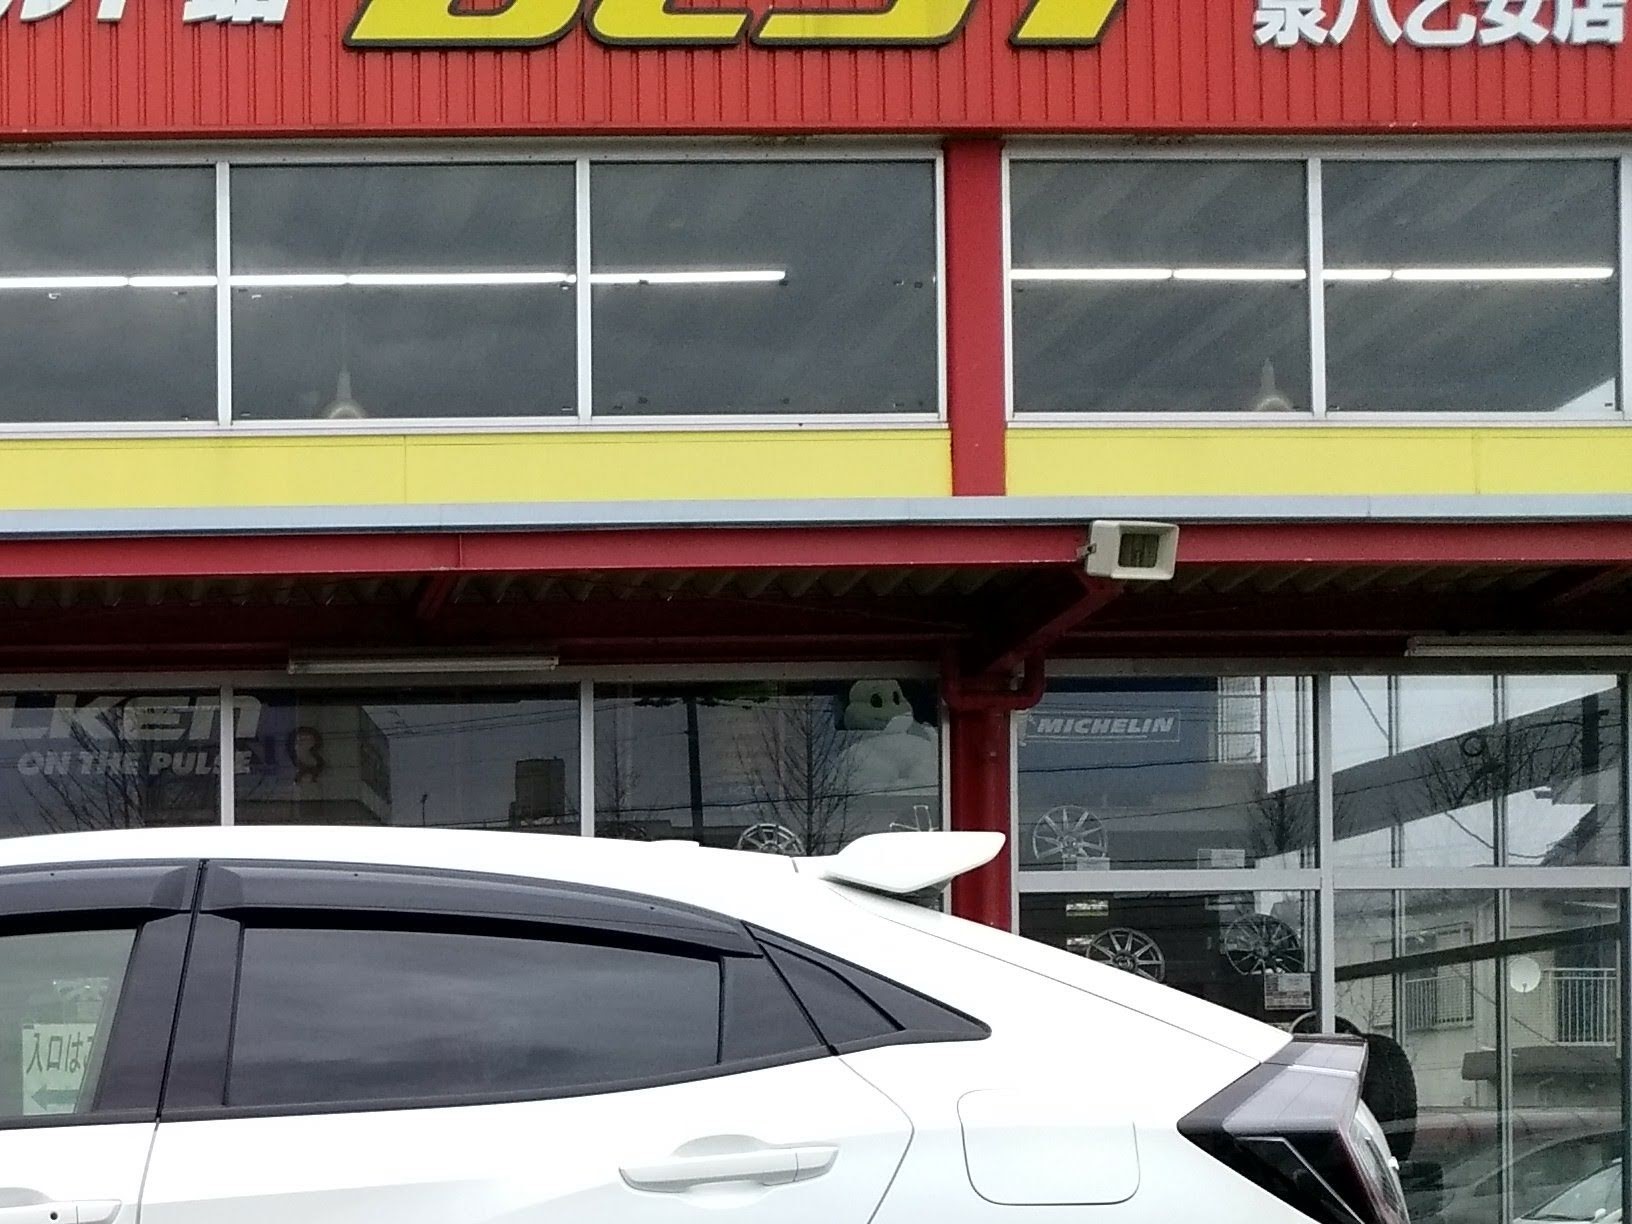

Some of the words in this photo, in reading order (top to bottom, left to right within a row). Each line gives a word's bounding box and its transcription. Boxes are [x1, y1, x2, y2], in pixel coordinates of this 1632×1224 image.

[1037, 717, 1174, 734] MICHELIN
[17, 751, 72, 776] ON
[79, 750, 139, 775] THE
